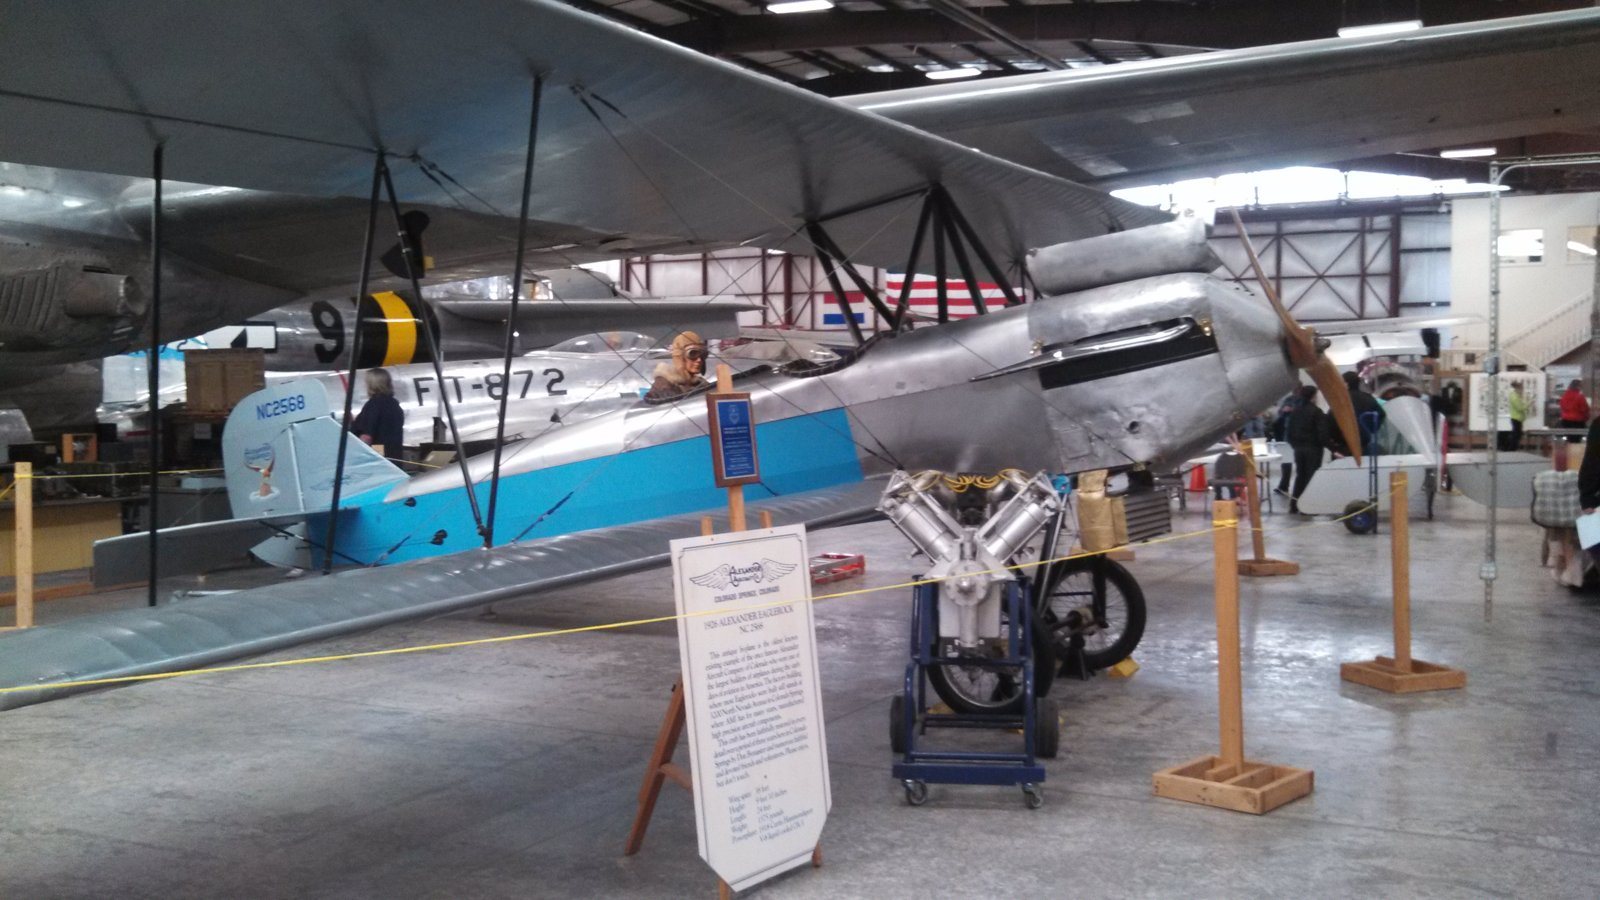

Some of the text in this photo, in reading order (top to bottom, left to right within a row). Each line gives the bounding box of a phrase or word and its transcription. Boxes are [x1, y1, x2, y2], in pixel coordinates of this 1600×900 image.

[311, 300, 344, 364] 9
[413, 368, 567, 406] FT-872
[256, 394, 305, 420] NC2568
